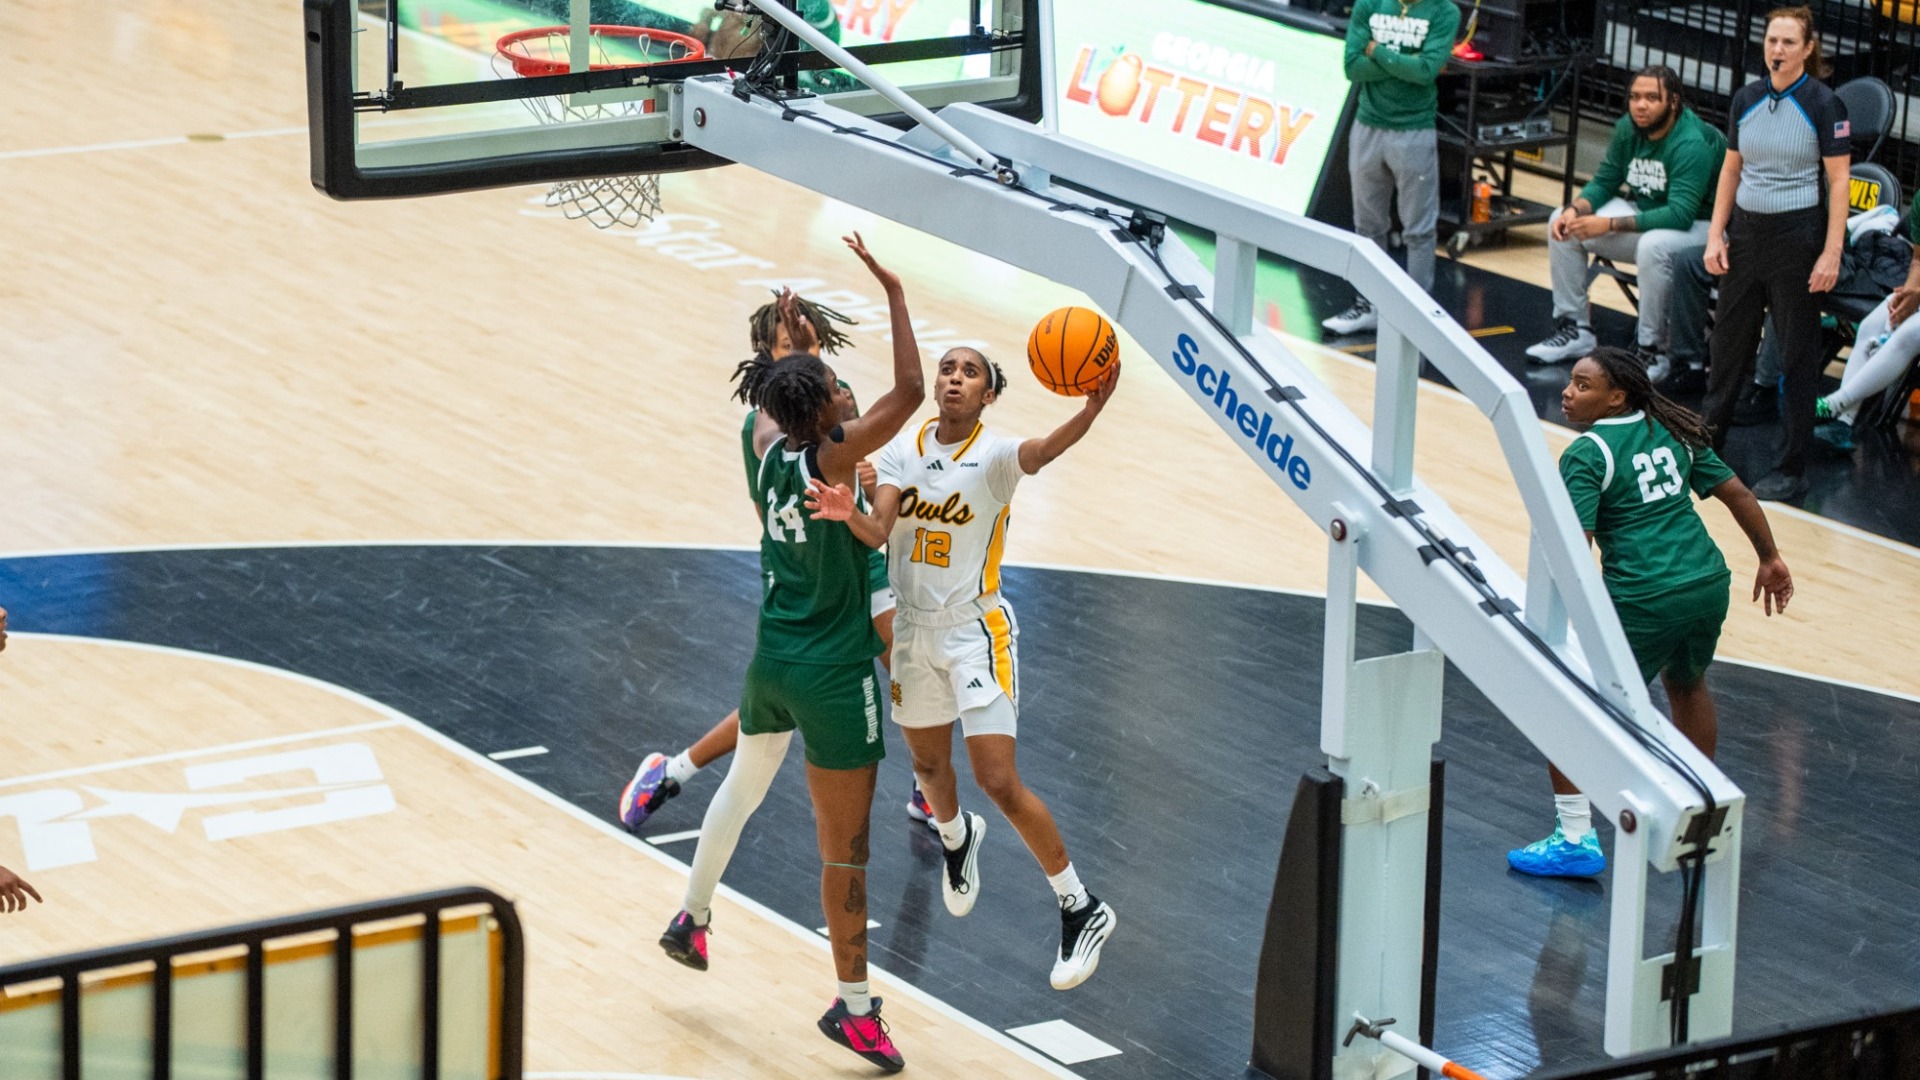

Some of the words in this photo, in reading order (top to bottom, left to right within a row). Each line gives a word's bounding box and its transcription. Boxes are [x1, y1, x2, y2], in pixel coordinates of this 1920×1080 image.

[1151, 31, 1276, 92] GEORGIA
[1066, 46, 1314, 165] LOTTERY
[1849, 178, 1880, 211] WLS
[1172, 332, 1311, 491] Schelde
[1632, 446, 1684, 504] 23
[899, 486, 975, 526] Owls
[909, 526, 952, 569] 12
